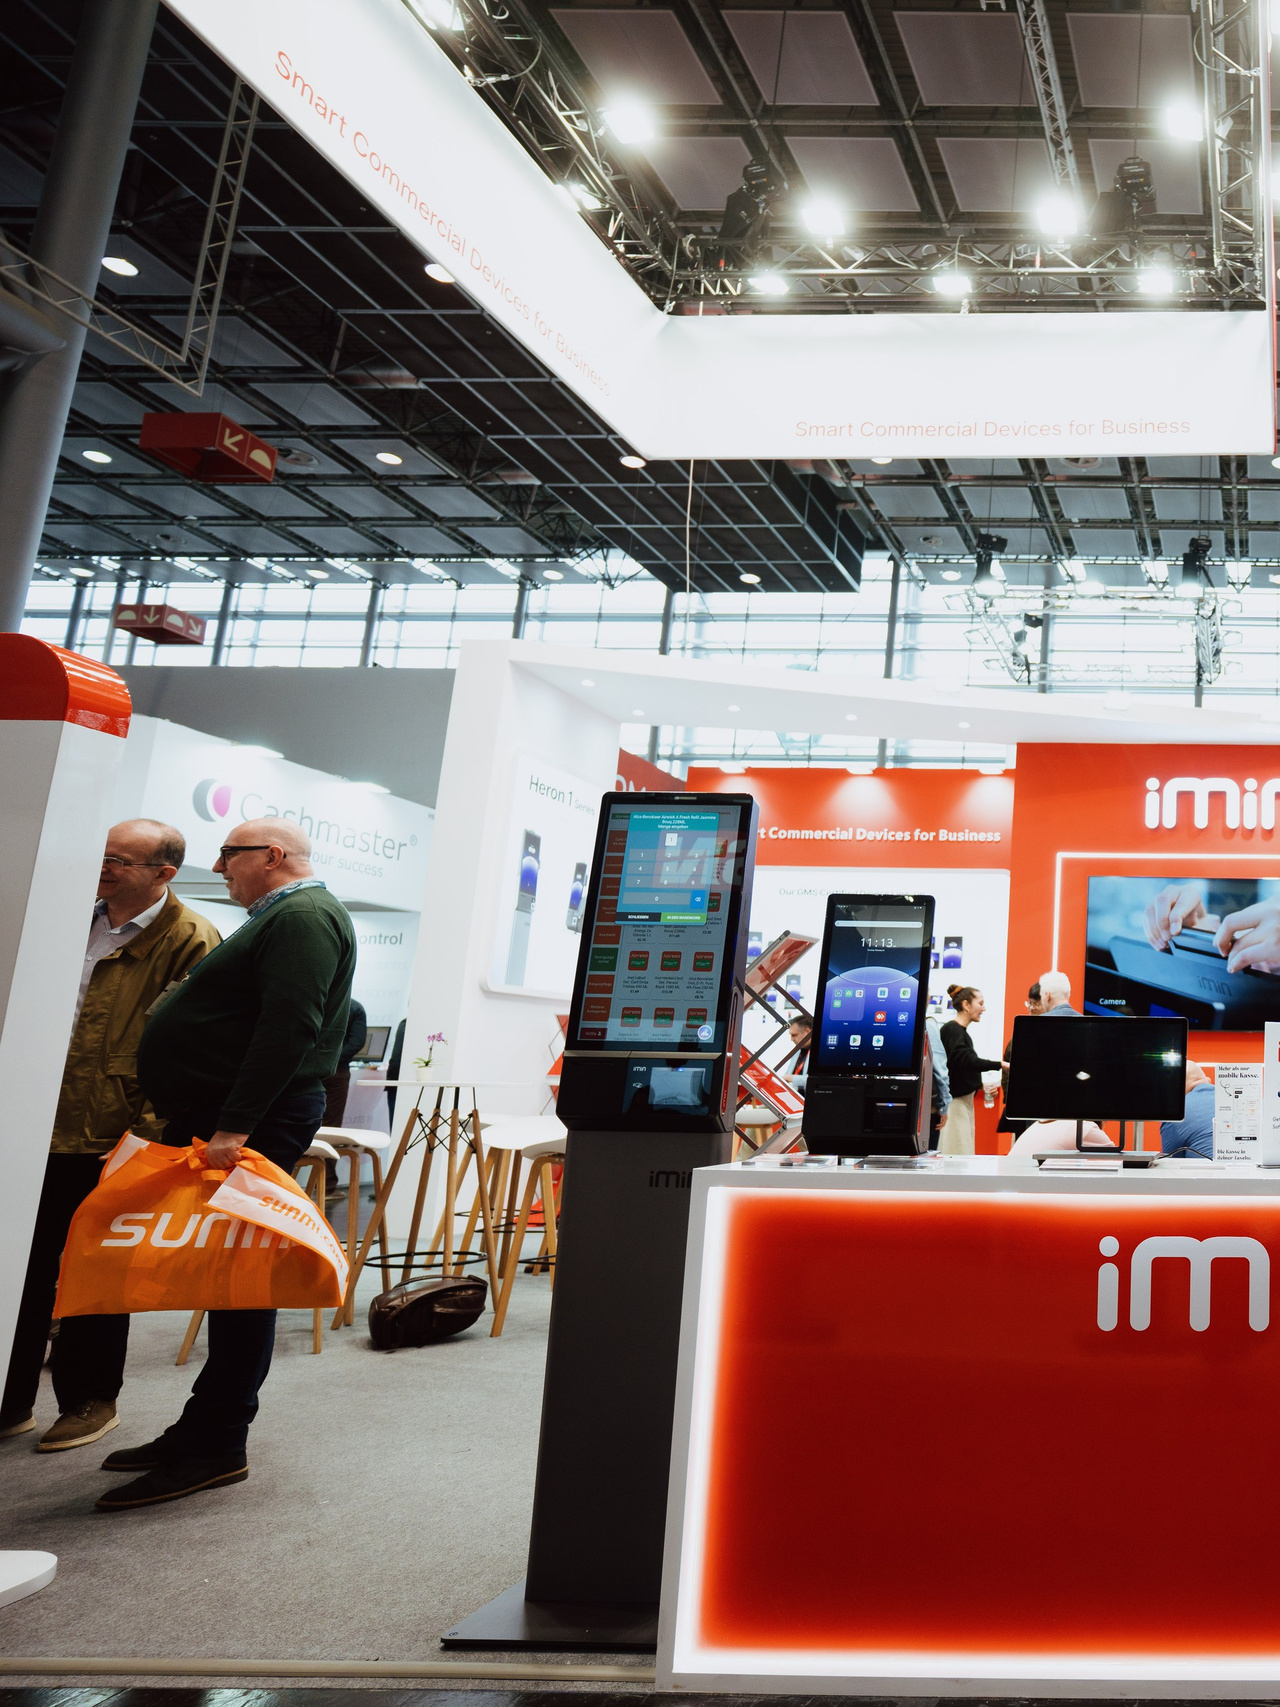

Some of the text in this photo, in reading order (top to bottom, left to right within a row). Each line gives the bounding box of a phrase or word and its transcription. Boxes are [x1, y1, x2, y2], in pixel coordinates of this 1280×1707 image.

[275, 51, 611, 397] Smart Commercial Devices for Business
[795, 418, 1191, 437] Smart Commercial Devices for Business
[529, 775, 566, 804] Heron
[568, 791, 573, 806] 1
[769, 827, 853, 841] Commercial
[856, 828, 911, 841] Devices
[914, 829, 935, 841] for
[939, 829, 1001, 842] Business
[338, 858, 384, 878] success
[779, 887, 795, 896] Our
[797, 888, 819, 896] GMS
[861, 938, 893, 948] 11:13
[1099, 998, 1126, 1006] Camera
[258, 1195, 344, 1271] sunmi.com
